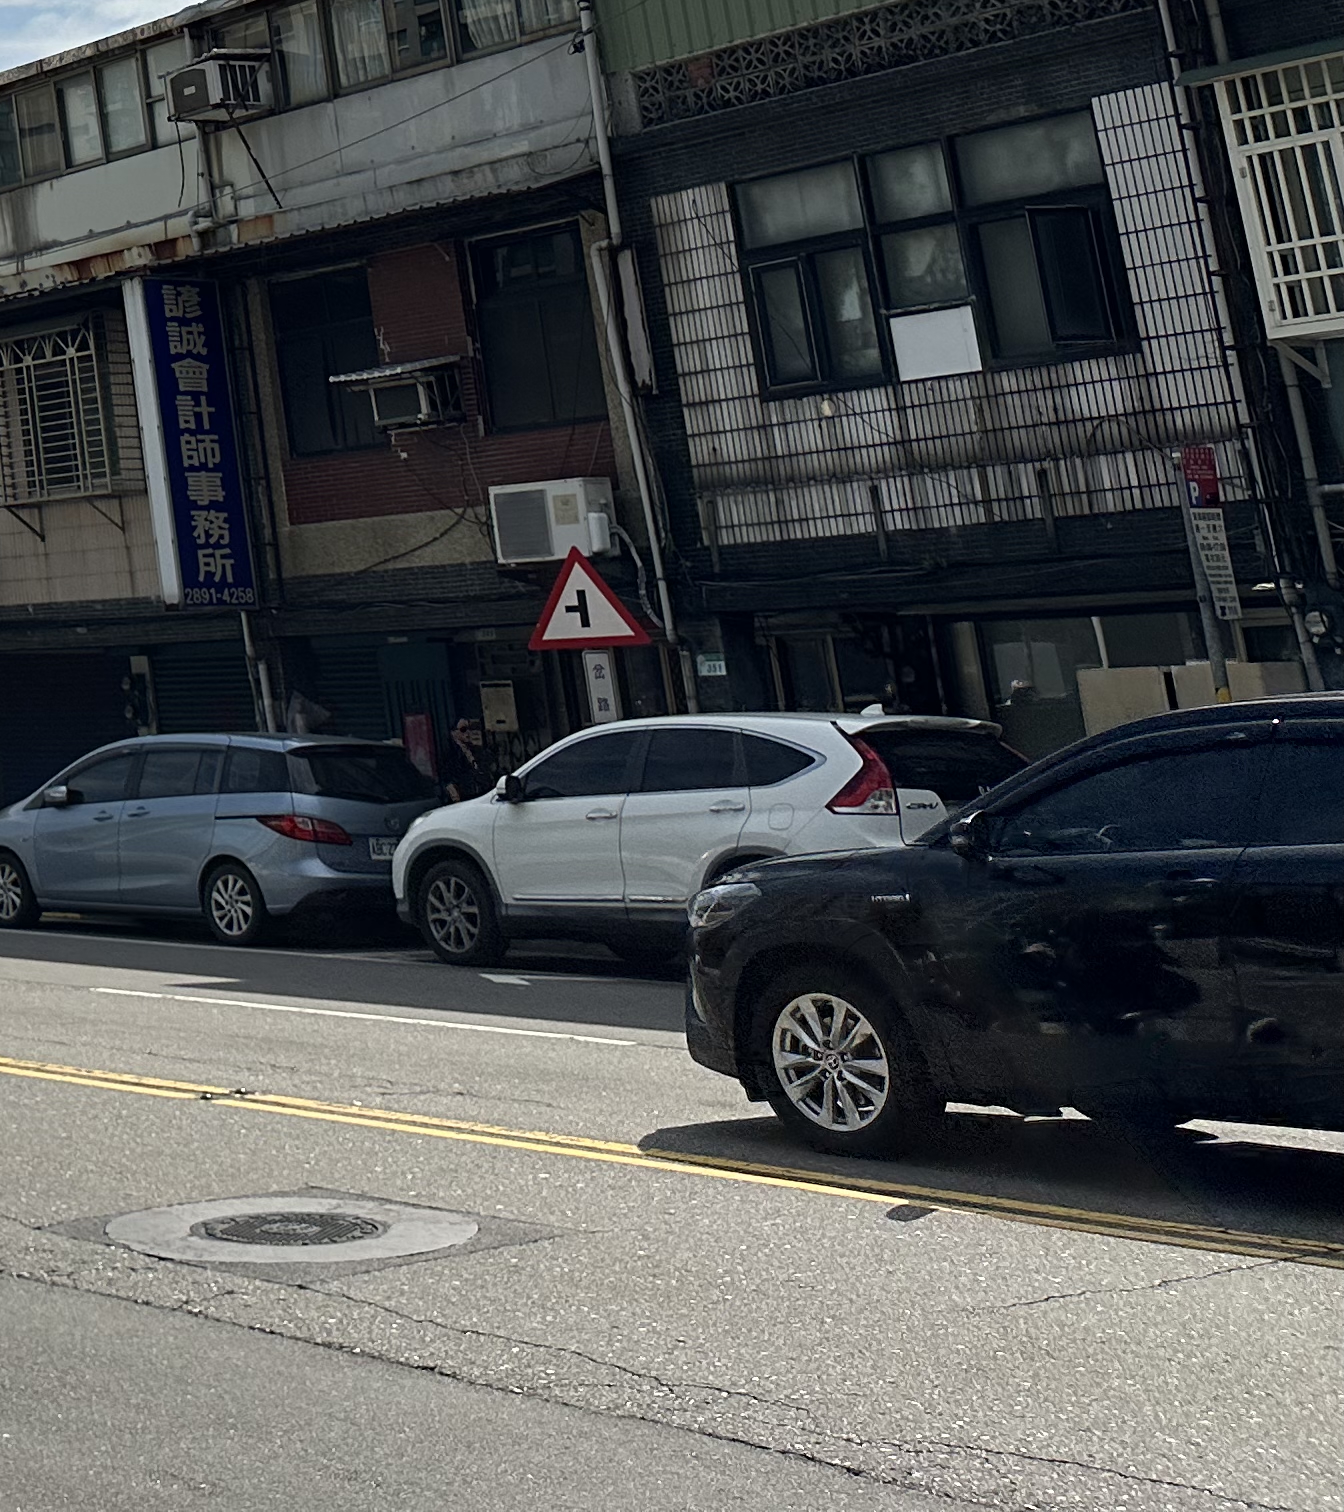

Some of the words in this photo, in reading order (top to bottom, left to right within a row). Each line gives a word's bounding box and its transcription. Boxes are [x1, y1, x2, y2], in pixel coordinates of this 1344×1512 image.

[161, 284, 235, 584] 諺誠會計師事務所
[184, 587, 254, 606] 2891-4258
[592, 663, 610, 713] 岔路
